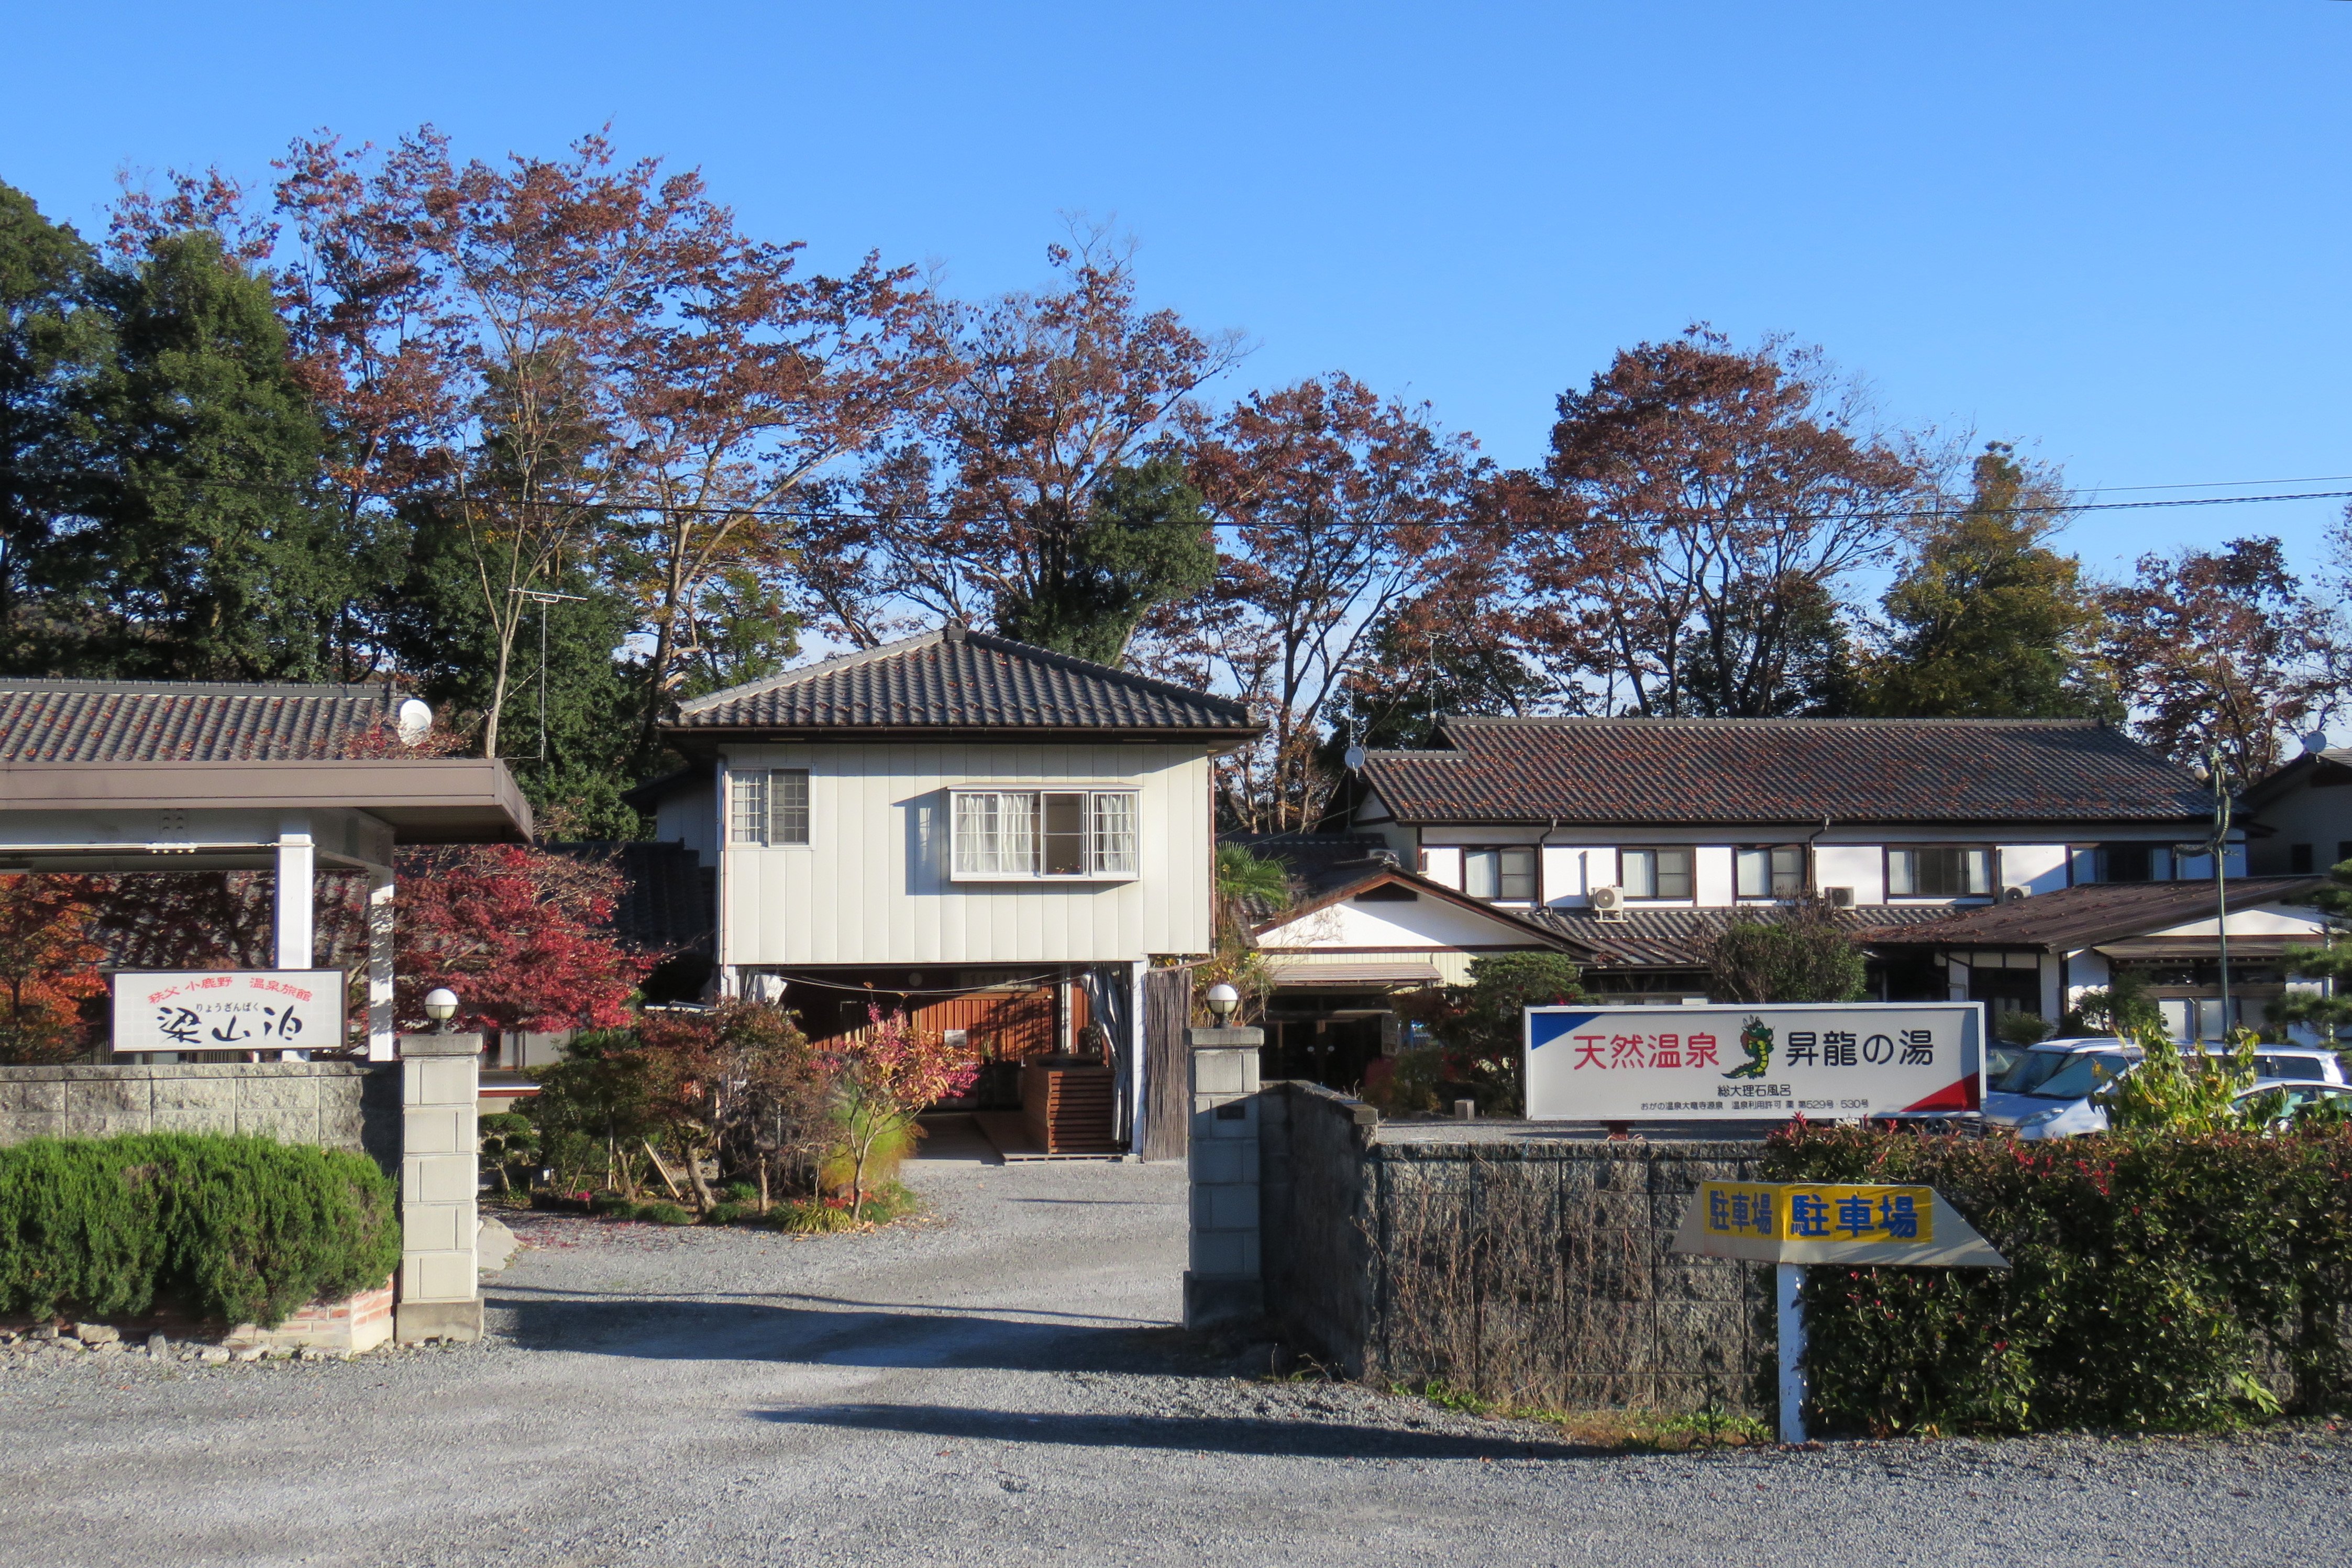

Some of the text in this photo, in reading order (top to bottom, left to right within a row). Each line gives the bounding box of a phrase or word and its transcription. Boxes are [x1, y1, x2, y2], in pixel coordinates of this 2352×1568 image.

[147, 976, 313, 1004] 秩父 小鹿野 温泉旅館
[157, 1004, 303, 1044] 梁山泊
[1573, 1032, 1720, 1070] 天然温泉
[1785, 1029, 1934, 1066] 昇龍の湯
[1717, 1084, 1791, 1097] 総大理石風呂
[1731, 1100, 1781, 1110] 温泉利用許可
[1709, 1190, 1772, 1234] 駐車場
[1791, 1194, 1918, 1238] 駐車場
